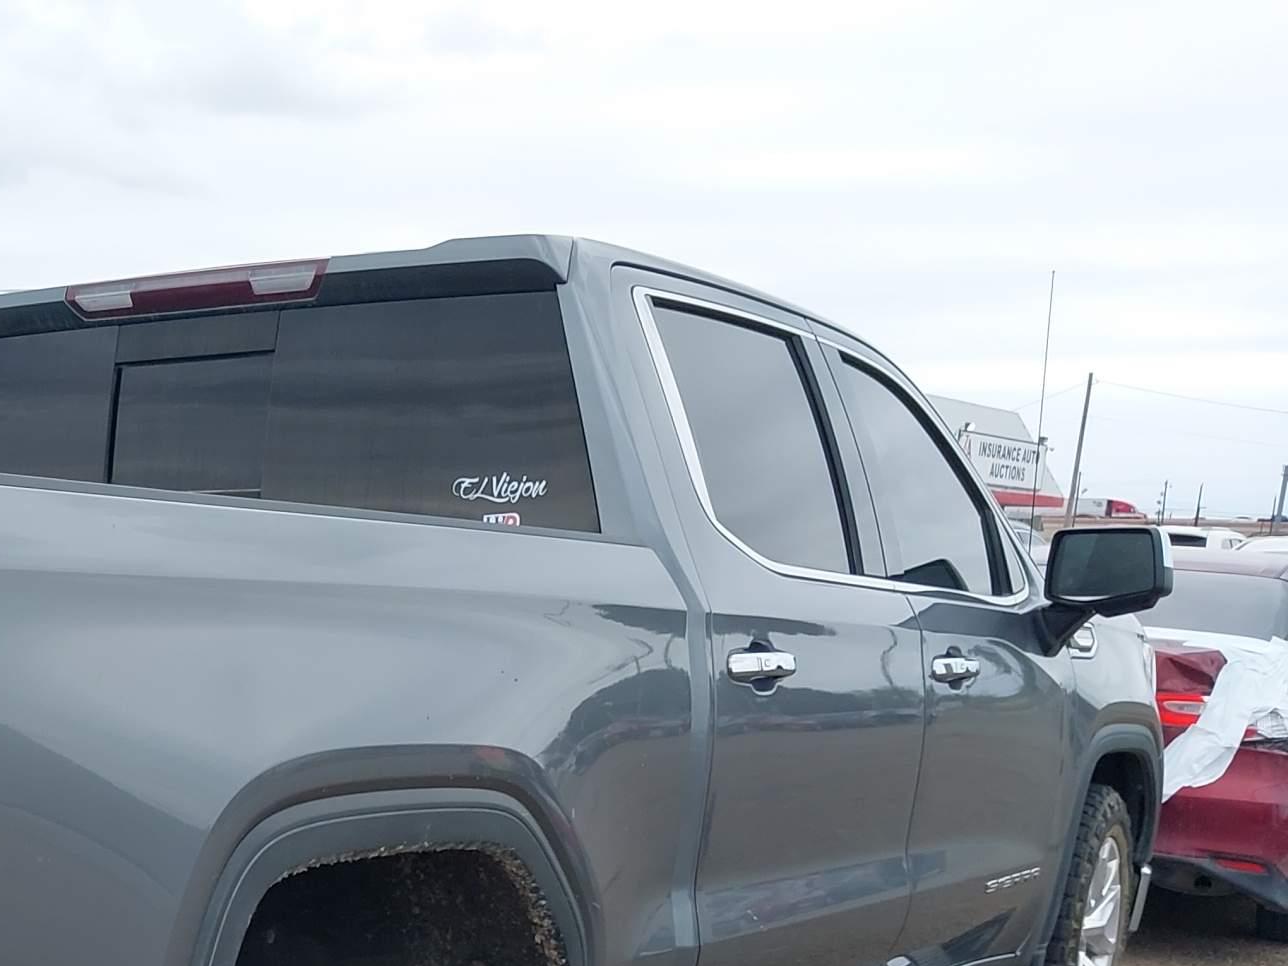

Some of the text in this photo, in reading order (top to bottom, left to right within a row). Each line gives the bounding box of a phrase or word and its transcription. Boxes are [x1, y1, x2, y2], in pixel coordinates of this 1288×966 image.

[978, 441, 1022, 463] INSURANCE
[989, 463, 1026, 482] AUCTIONS
[492, 471, 549, 504] Viejon
[984, 866, 1041, 893] SIERRA
